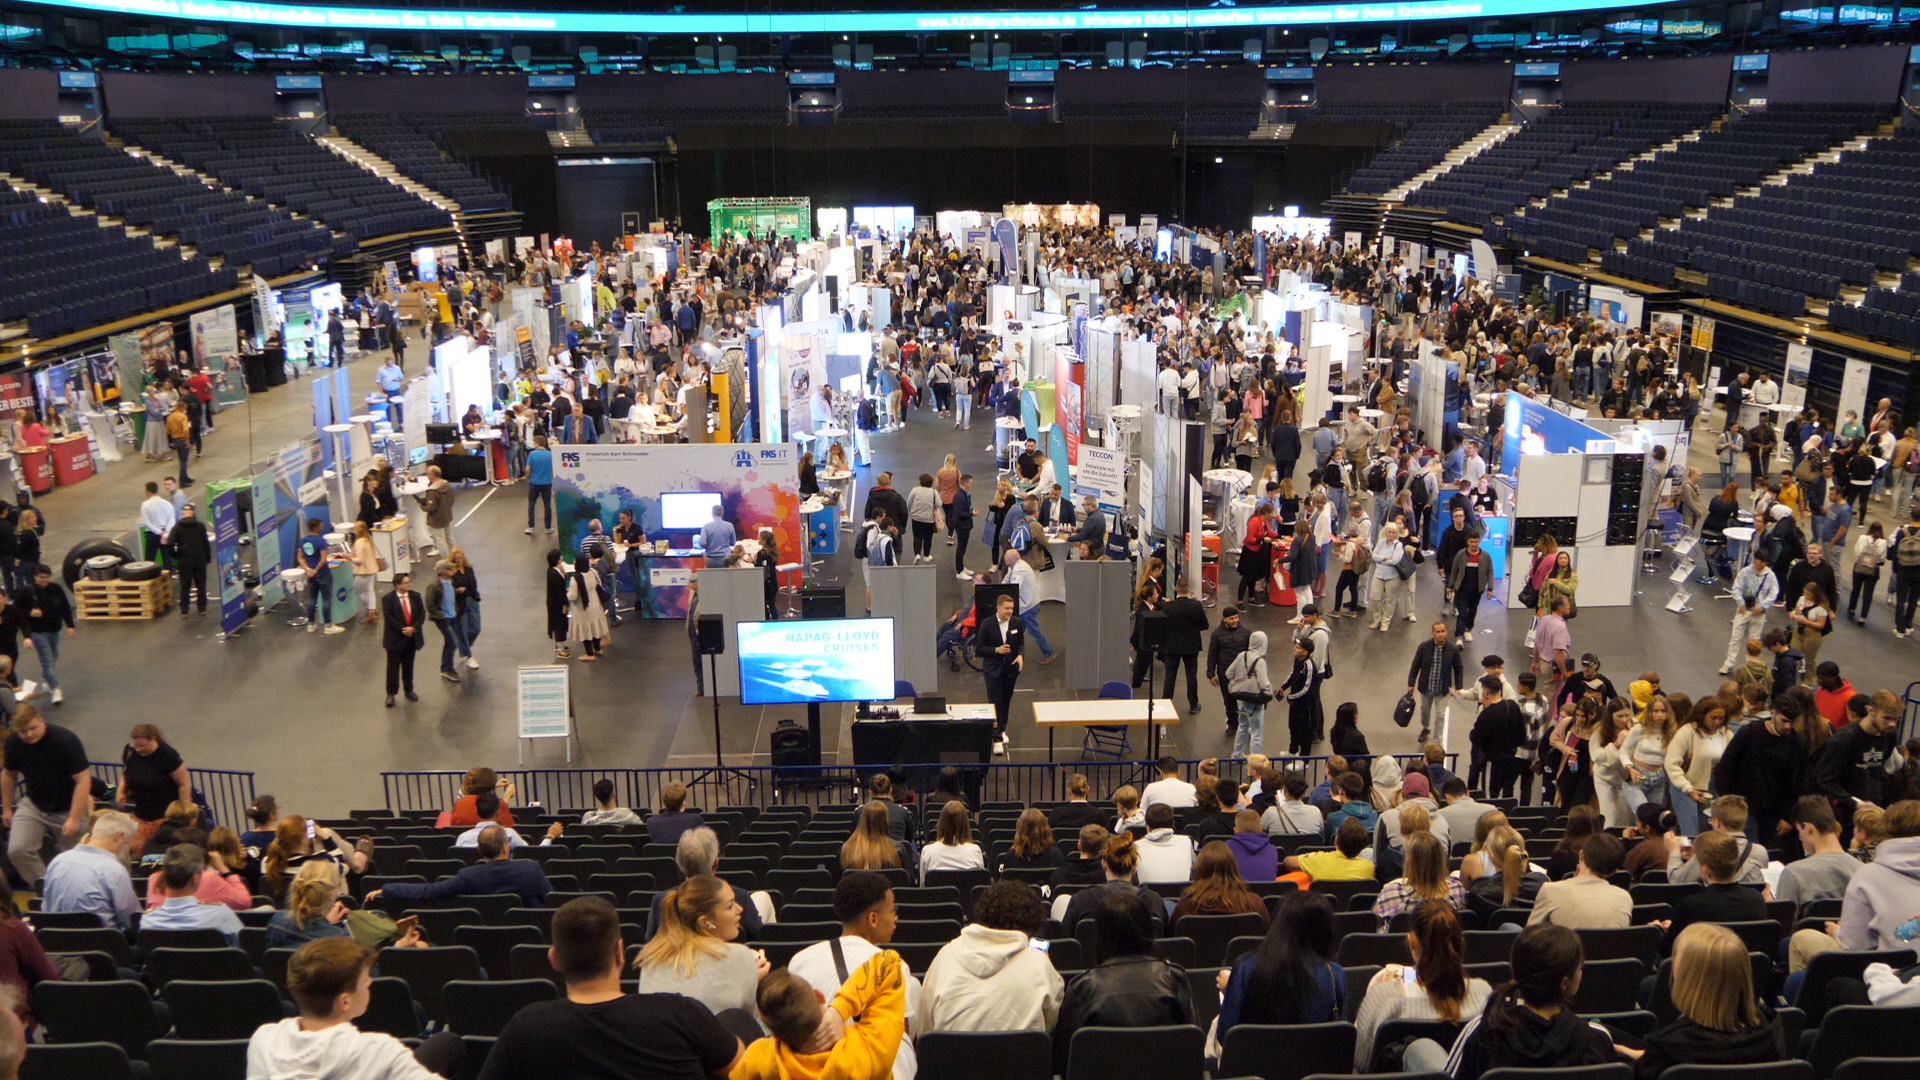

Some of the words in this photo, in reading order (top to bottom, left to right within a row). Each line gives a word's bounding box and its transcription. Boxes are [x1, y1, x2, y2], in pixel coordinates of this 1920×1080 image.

[918, 16, 1076, 29] www.AZUBIsprechstunde.de
[1083, 14, 1142, 26] Informiere
[1145, 14, 1171, 25] Dich
[1172, 13, 1191, 24] bei
[1194, 11, 1254, 23] namhaften
[1257, 9, 1332, 22] Unternehmen
[1335, 7, 1360, 20] über
[1362, 5, 1395, 19] Deine
[1397, 3, 1482, 17] Karrierechancen
[561, 452, 580, 462] FKS
[760, 450, 776, 459] FKS
[778, 450, 788, 458] IT
[1089, 450, 1113, 460] TECCON
[1085, 463, 1107, 471] Entwickle
[1098, 471, 1118, 479] Zukunft!
[785, 630, 879, 643] HAPAG-LLOYD
[823, 642, 879, 653] CRUISES
